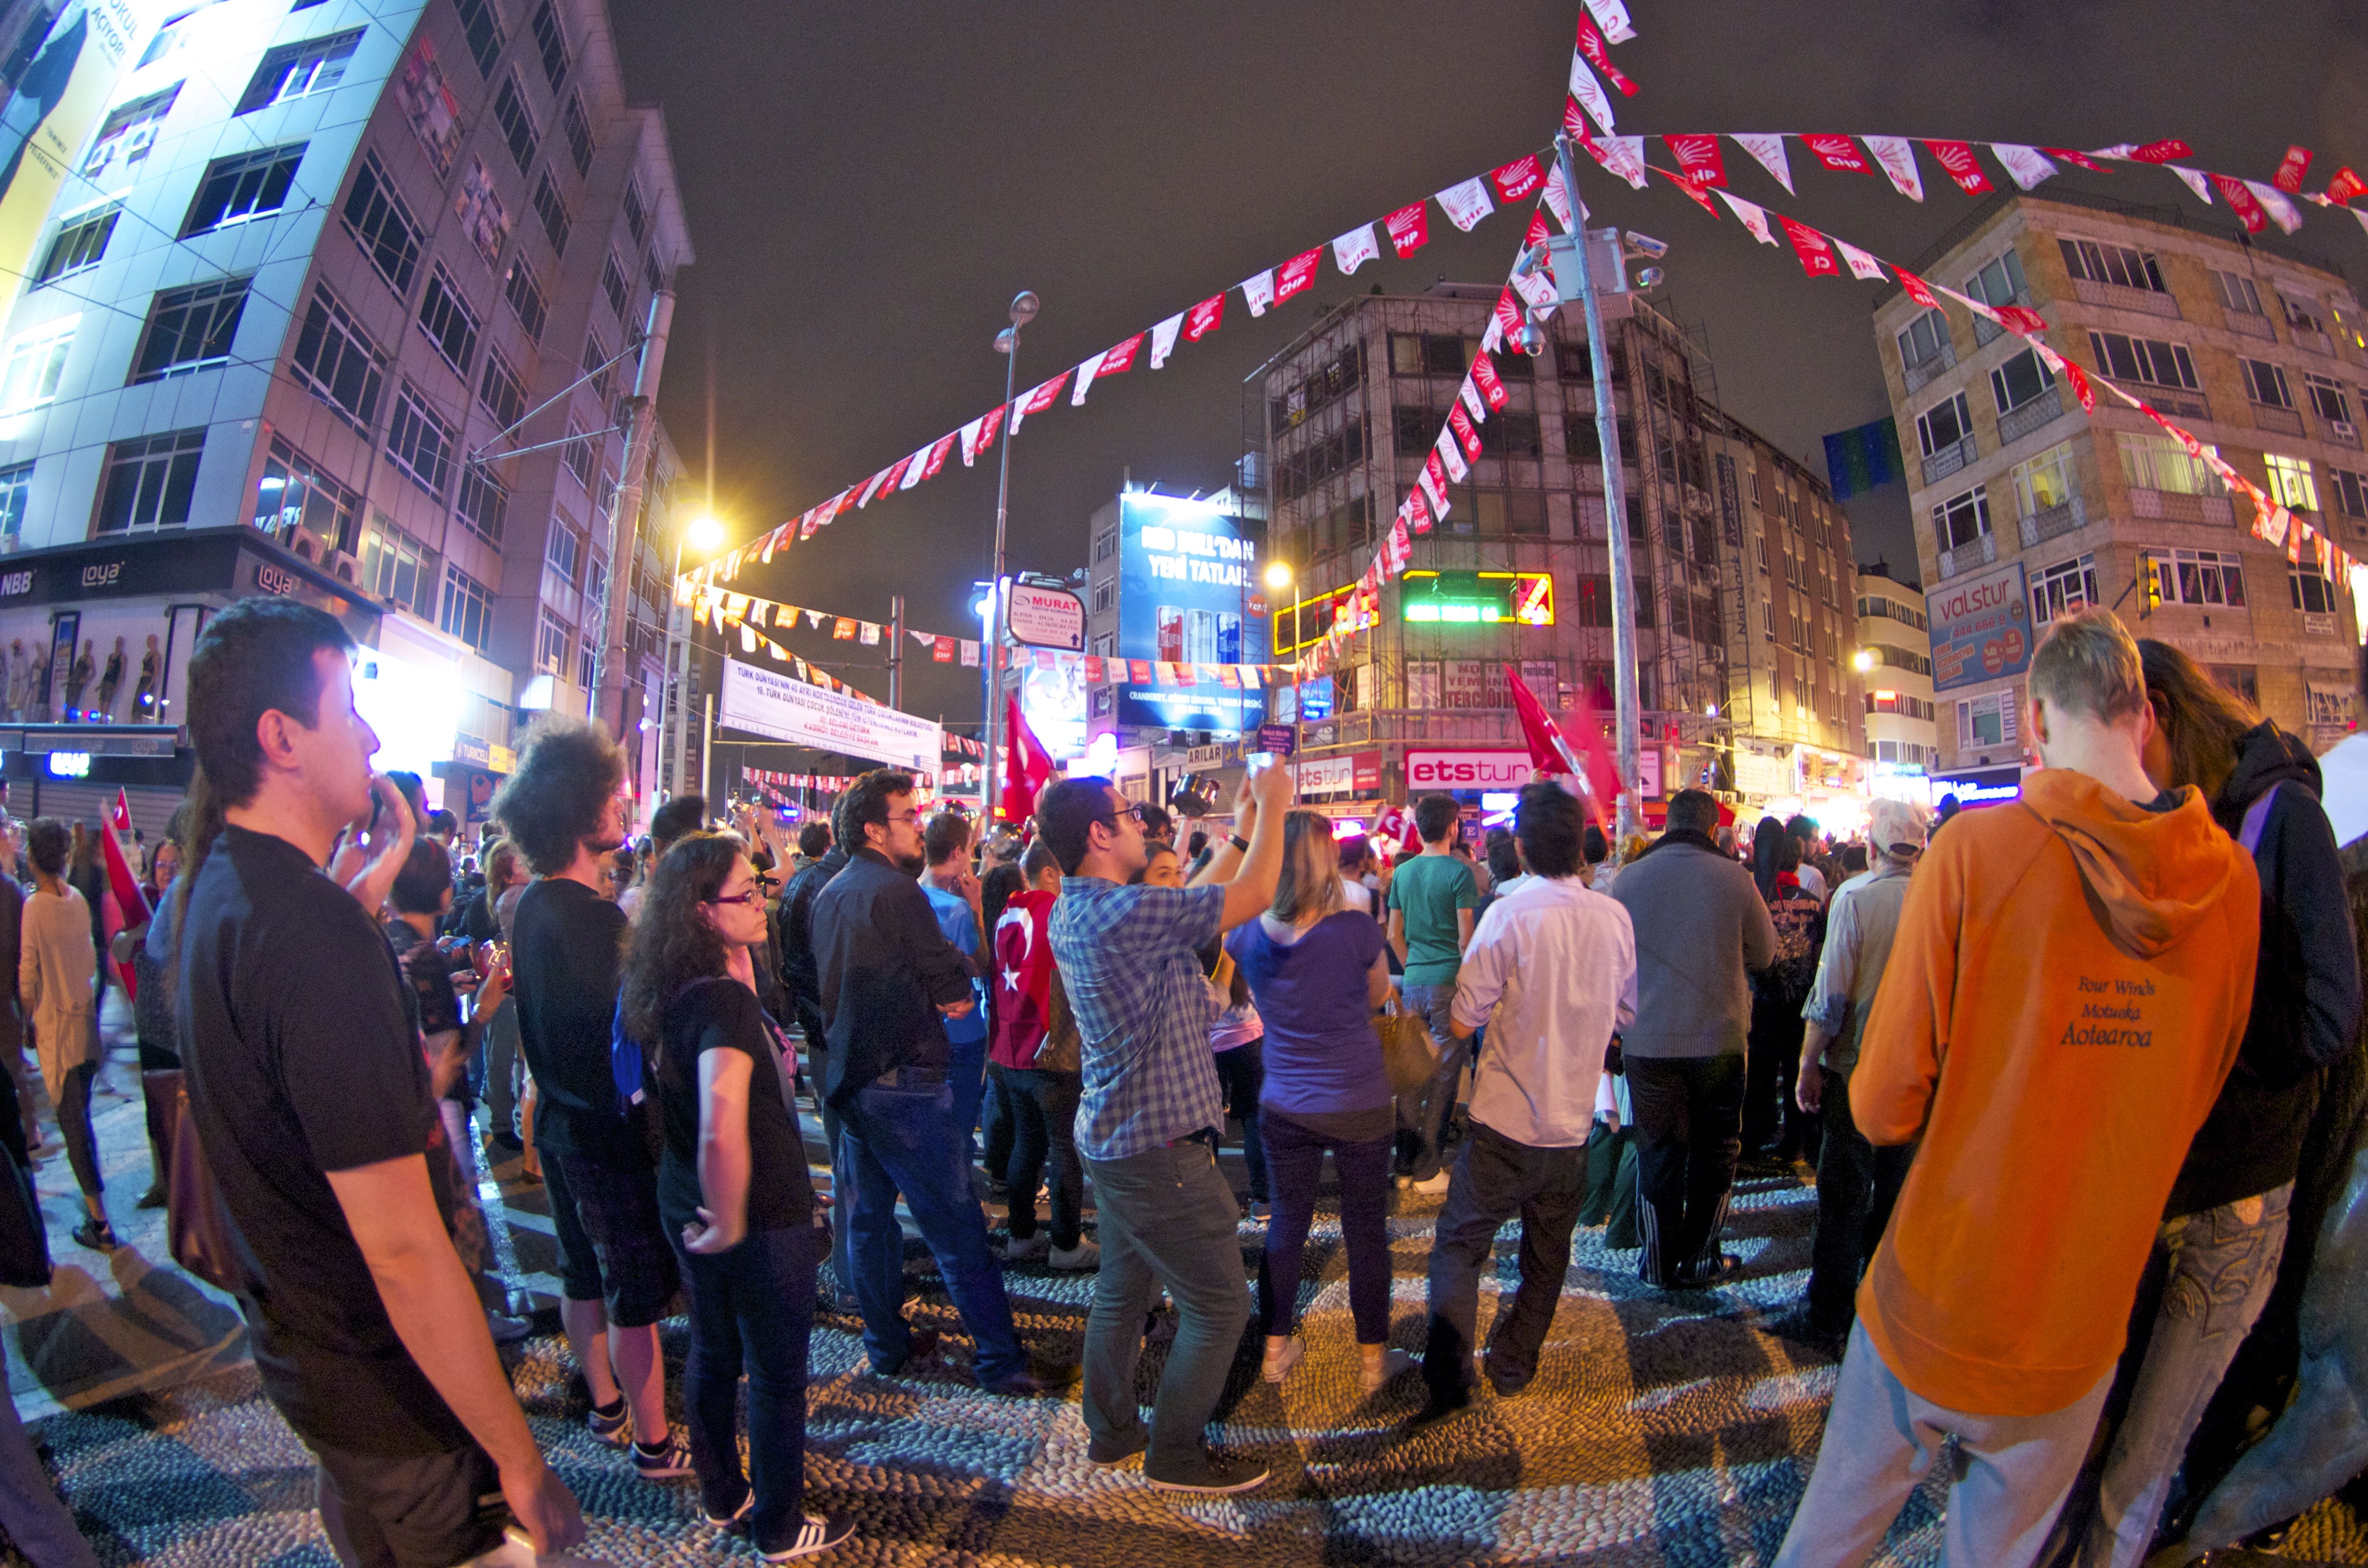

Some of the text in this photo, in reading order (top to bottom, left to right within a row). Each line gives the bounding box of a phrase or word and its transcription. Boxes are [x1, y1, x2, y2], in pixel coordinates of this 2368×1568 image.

[91, 7, 126, 61] AÇIYOR!
[1826, 155, 1861, 169] CHP
[1505, 173, 1537, 198] CHP
[1457, 205, 1484, 231] CHP
[1345, 247, 1370, 272] CHP
[1279, 275, 1307, 296] CHP
[1249, 291, 1266, 309] HP
[1190, 315, 1215, 337] CHP
[1100, 357, 1128, 372] CHP
[1027, 397, 1050, 410] CHP
[1148, 553, 1187, 580] YENİ
[0, 571, 32, 596] NBB
[1032, 596, 1078, 611] MURAT
[1940, 579, 2010, 621] valstur
[738, 666, 754, 679] TÜRK
[755, 672, 789, 690] DÜNYASI'NIN
[791, 683, 798, 693] 40
[799, 686, 812, 697] AYRI
[848, 700, 863, 711] GELEN
[863, 704, 876, 715] TÜRK
[766, 687, 782, 700] TÜRK
[782, 692, 806, 707] DÜNYASI
[806, 700, 825, 713] ÇOCUK
[803, 722, 829, 735] KADIKÖY
[463, 744, 489, 763] TURKCELL
[1188, 746, 1221, 764] ARILAR
[1299, 766, 1351, 787] etstur
[1414, 760, 1528, 782] etstur
[2078, 976, 2156, 996] Four Winds
[2060, 1020, 2153, 1048] Aotearoa
